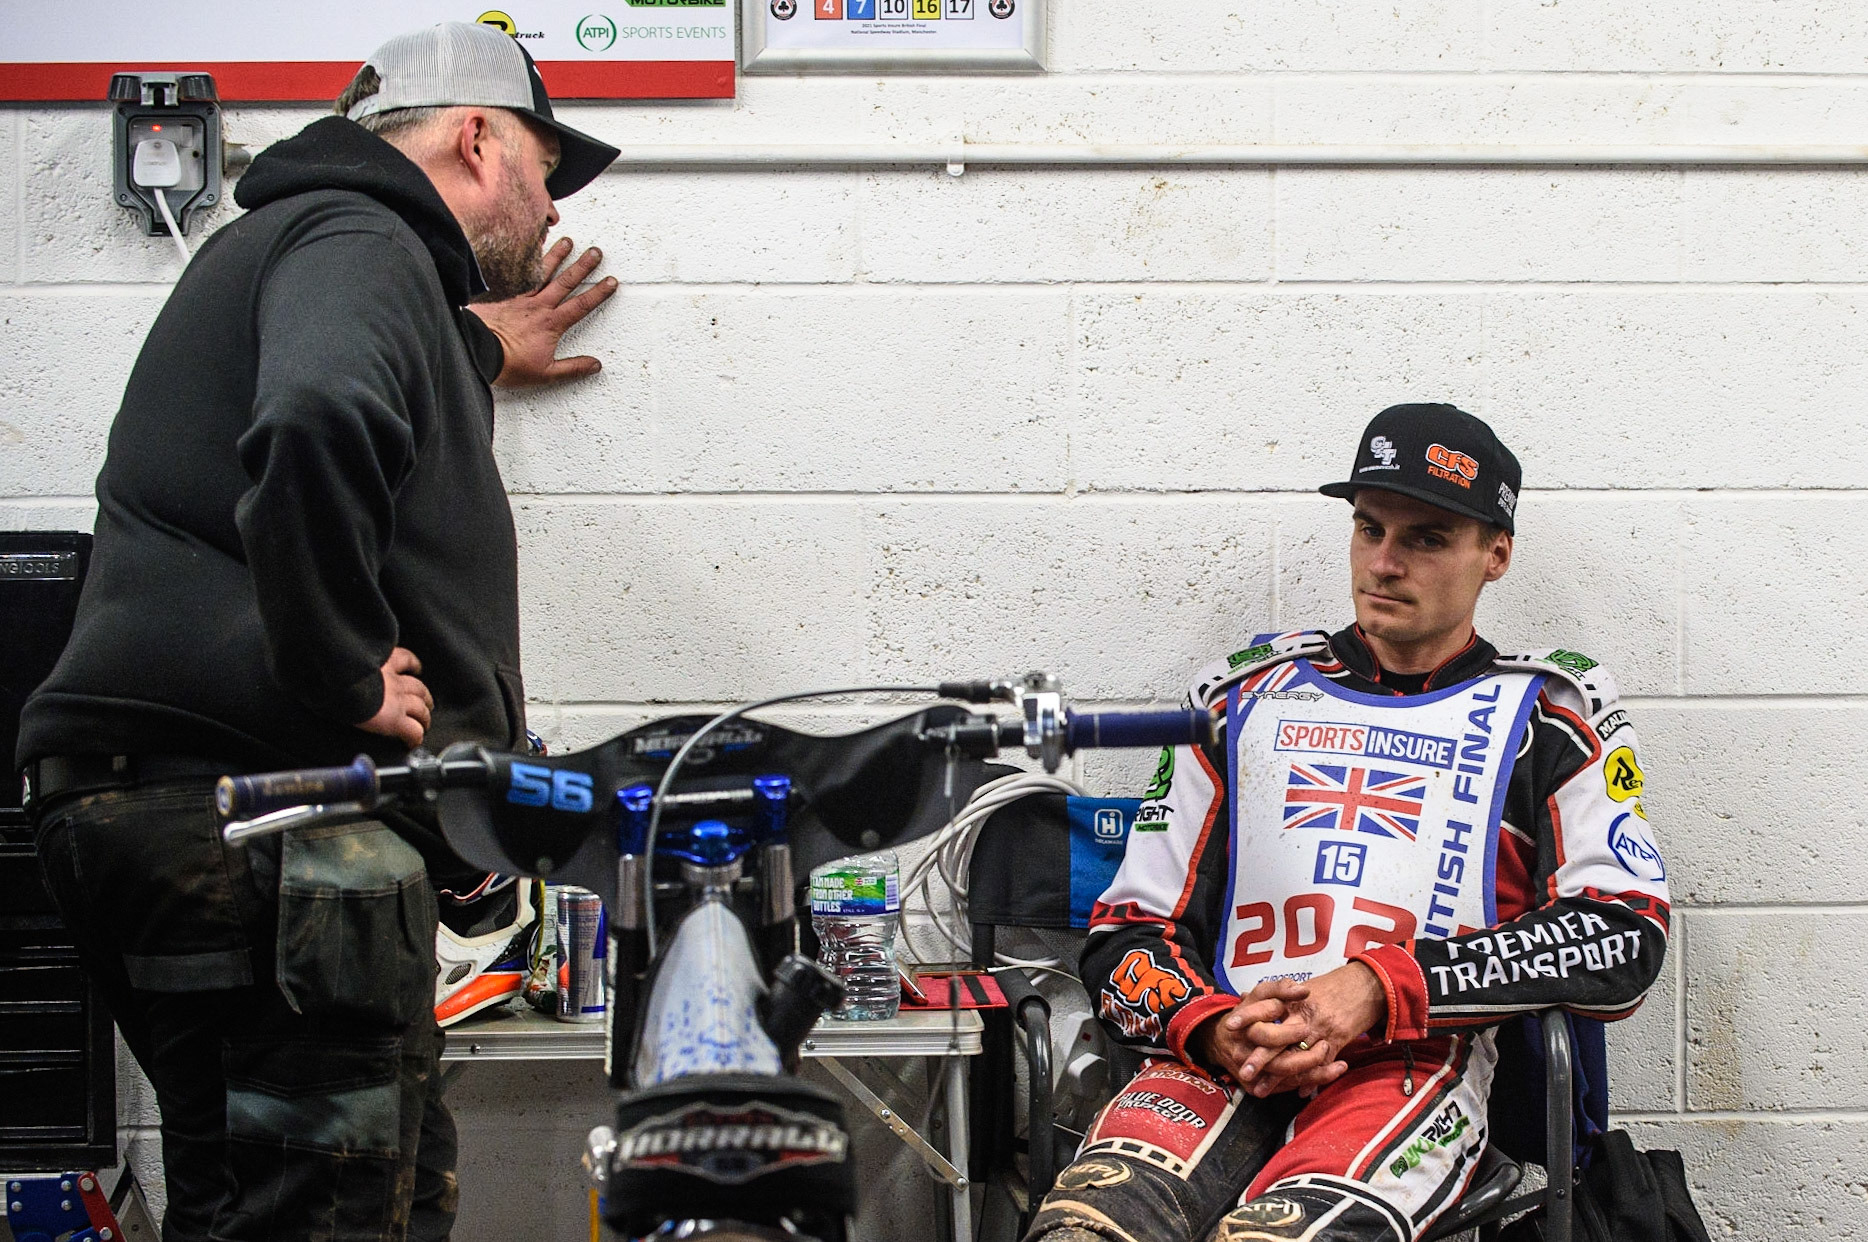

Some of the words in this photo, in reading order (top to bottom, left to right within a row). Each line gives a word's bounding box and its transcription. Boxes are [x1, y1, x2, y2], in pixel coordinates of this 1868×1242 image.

[822, 0, 835, 14] 4
[856, 0, 867, 14] 7
[883, 0, 905, 14] 10
[916, 0, 938, 14] 16
[949, 0, 969, 14] 17
[583, 27, 610, 39] ATPI
[622, 26, 674, 39] SPORTS
[677, 26, 726, 39] EVENTS
[1427, 445, 1478, 479] CFS
[1427, 465, 1471, 489] FILTRATION
[1241, 691, 1325, 702] SYNERGY
[1280, 725, 1365, 751] SPORTS
[1367, 730, 1452, 765] INSURE
[507, 762, 593, 812] 56
[1424, 819, 1473, 940] ITISH
[1452, 684, 1501, 804] FINAL
[1321, 844, 1361, 882] 15
[1230, 893, 1478, 968] 202
[1447, 911, 1610, 960] PREMIER
[1430, 929, 1642, 996] TRANSPORT
[1157, 1098, 1207, 1129] DOOR
